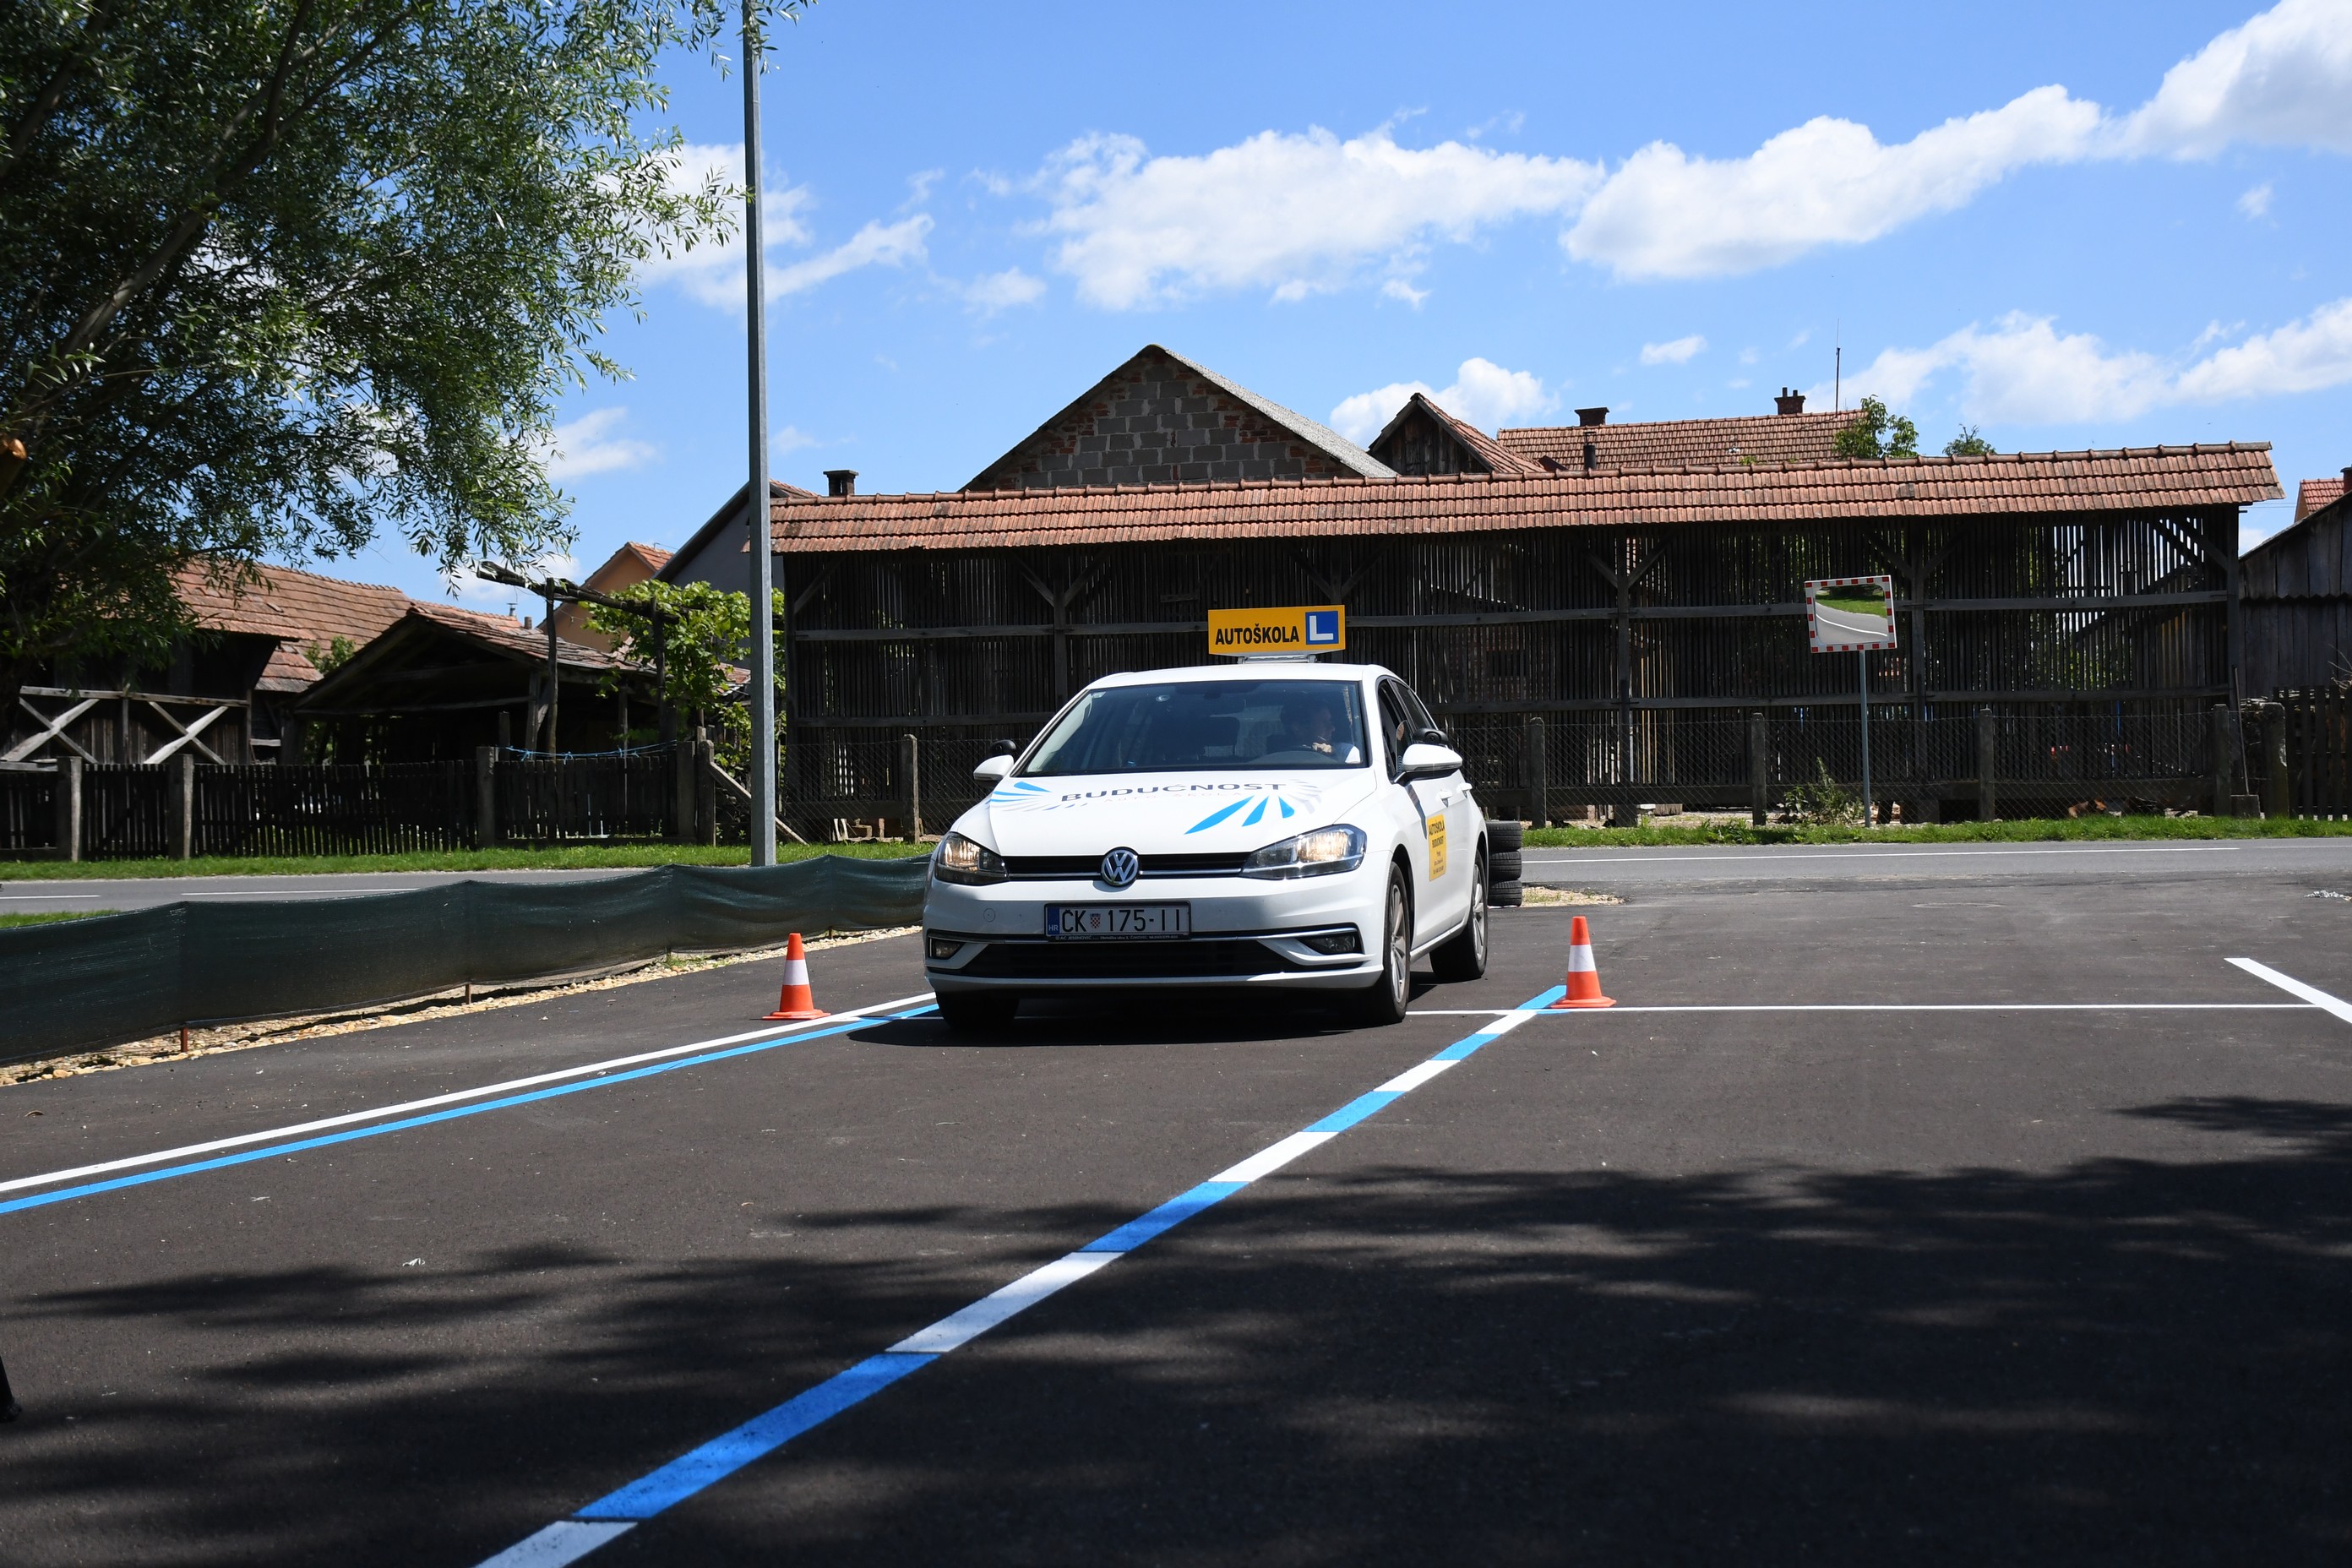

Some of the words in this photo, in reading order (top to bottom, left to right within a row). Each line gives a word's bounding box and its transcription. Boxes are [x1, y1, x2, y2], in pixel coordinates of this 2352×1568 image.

[1215, 623, 1299, 645] AUTOŠKOLA
[1309, 615, 1334, 641] L
[1061, 783, 1287, 802] BUDUĆNOST
[1062, 909, 1086, 932] ČK
